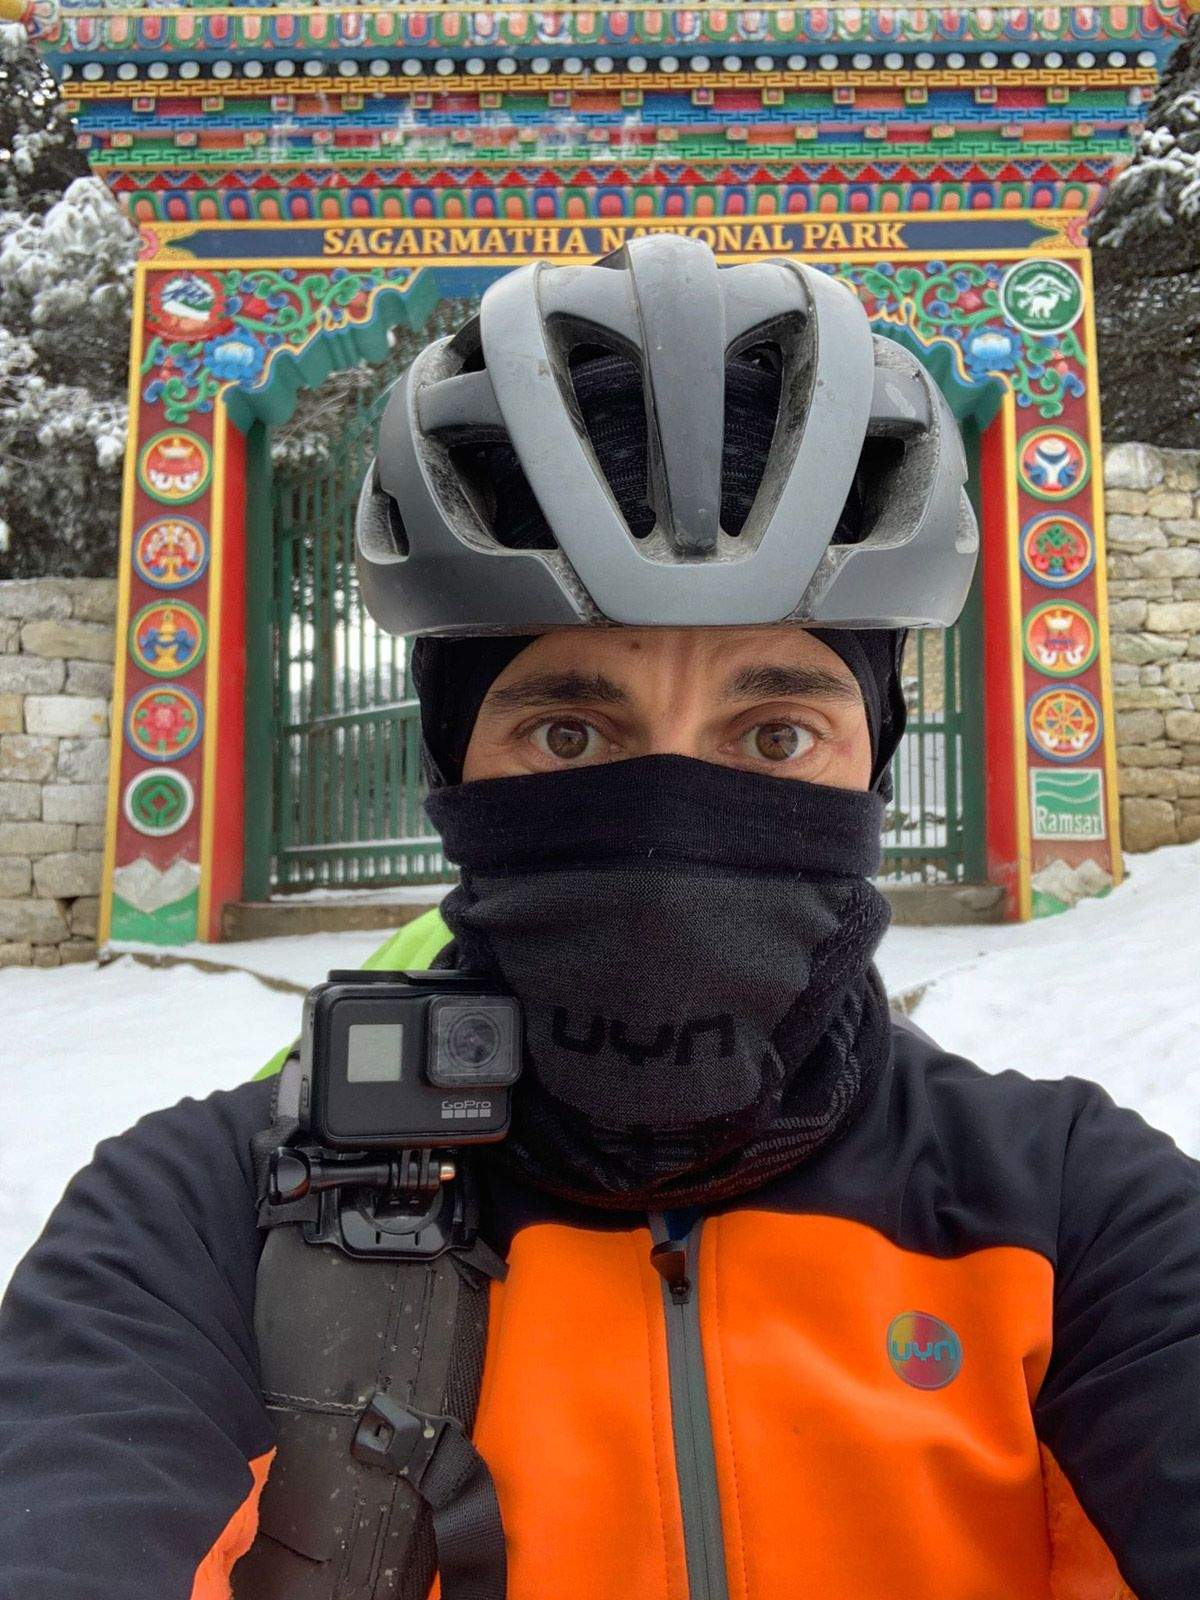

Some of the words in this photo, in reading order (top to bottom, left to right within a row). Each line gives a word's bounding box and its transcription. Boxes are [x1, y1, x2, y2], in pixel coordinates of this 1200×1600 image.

[322, 226, 591, 256] SAGARMATHA
[802, 221, 909, 249] PARK
[1035, 806, 1100, 833] Ramsar
[441, 1100, 492, 1110] GoPro
